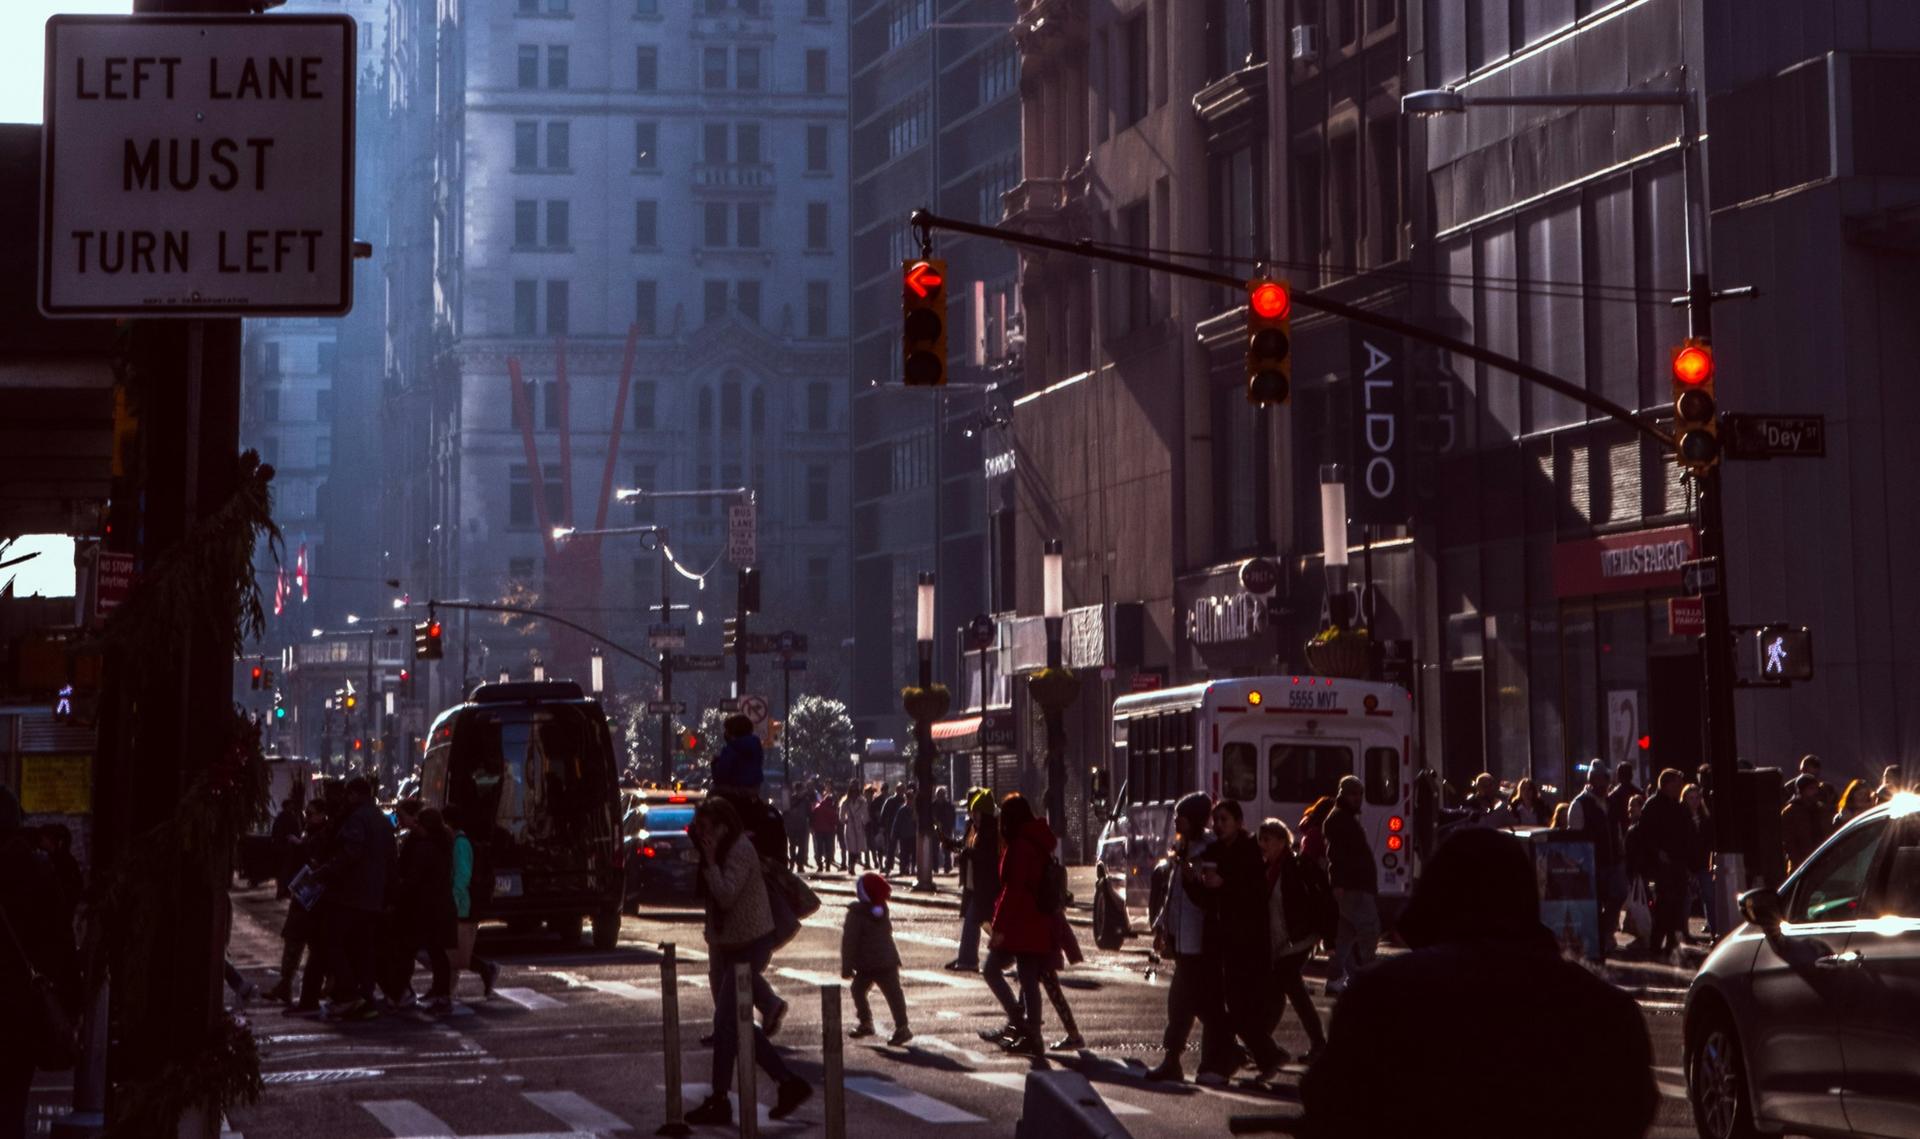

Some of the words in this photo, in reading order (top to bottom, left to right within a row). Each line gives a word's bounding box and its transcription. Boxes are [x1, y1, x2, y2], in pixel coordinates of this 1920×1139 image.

[76, 57, 182, 99] LEFT
[210, 56, 323, 99] LANE
[123, 138, 275, 192] MUST
[71, 230, 189, 274] TURN
[218, 230, 323, 273] LEFT
[1362, 340, 1395, 499] ALDO
[1768, 426, 1802, 452] Dey
[732, 519, 753, 528] LANE
[1601, 545, 1641, 577] WELLS
[1642, 540, 1687, 573] FARGO
[1319, 583, 1376, 631] ADO
[1317, 690, 1339, 710] MVT
[982, 729, 1014, 743] USHI
